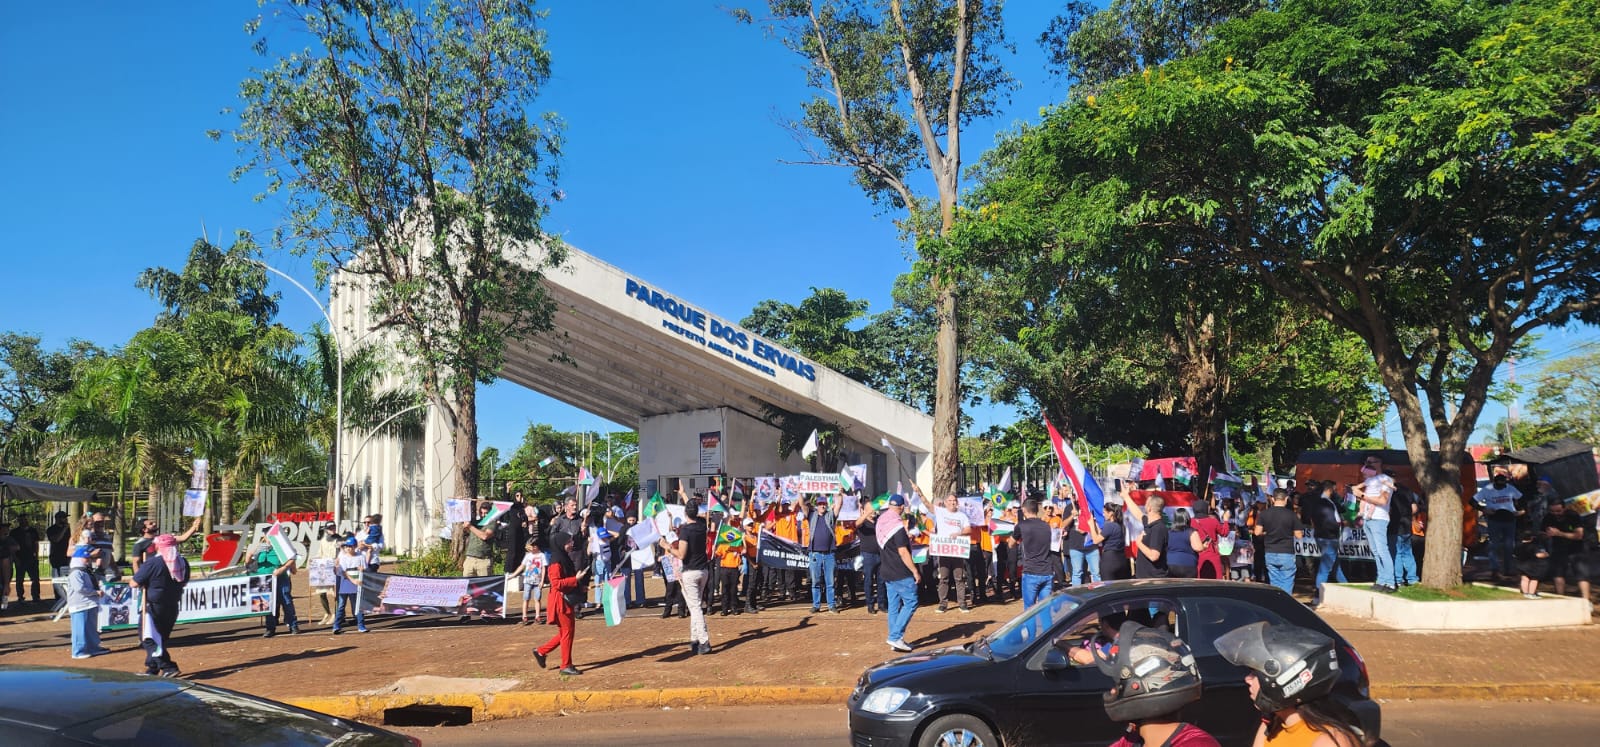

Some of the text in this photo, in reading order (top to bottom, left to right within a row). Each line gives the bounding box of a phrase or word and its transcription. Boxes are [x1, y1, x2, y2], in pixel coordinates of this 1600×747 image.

[625, 278, 816, 382] PARQUE DOS ERVAIS
[662, 319, 776, 377] PREFEITO AIRES MARQUES
[267, 512, 335, 522] CIDADE DE
[1303, 543, 1321, 554] POV
[211, 582, 248, 609] LIVRE
